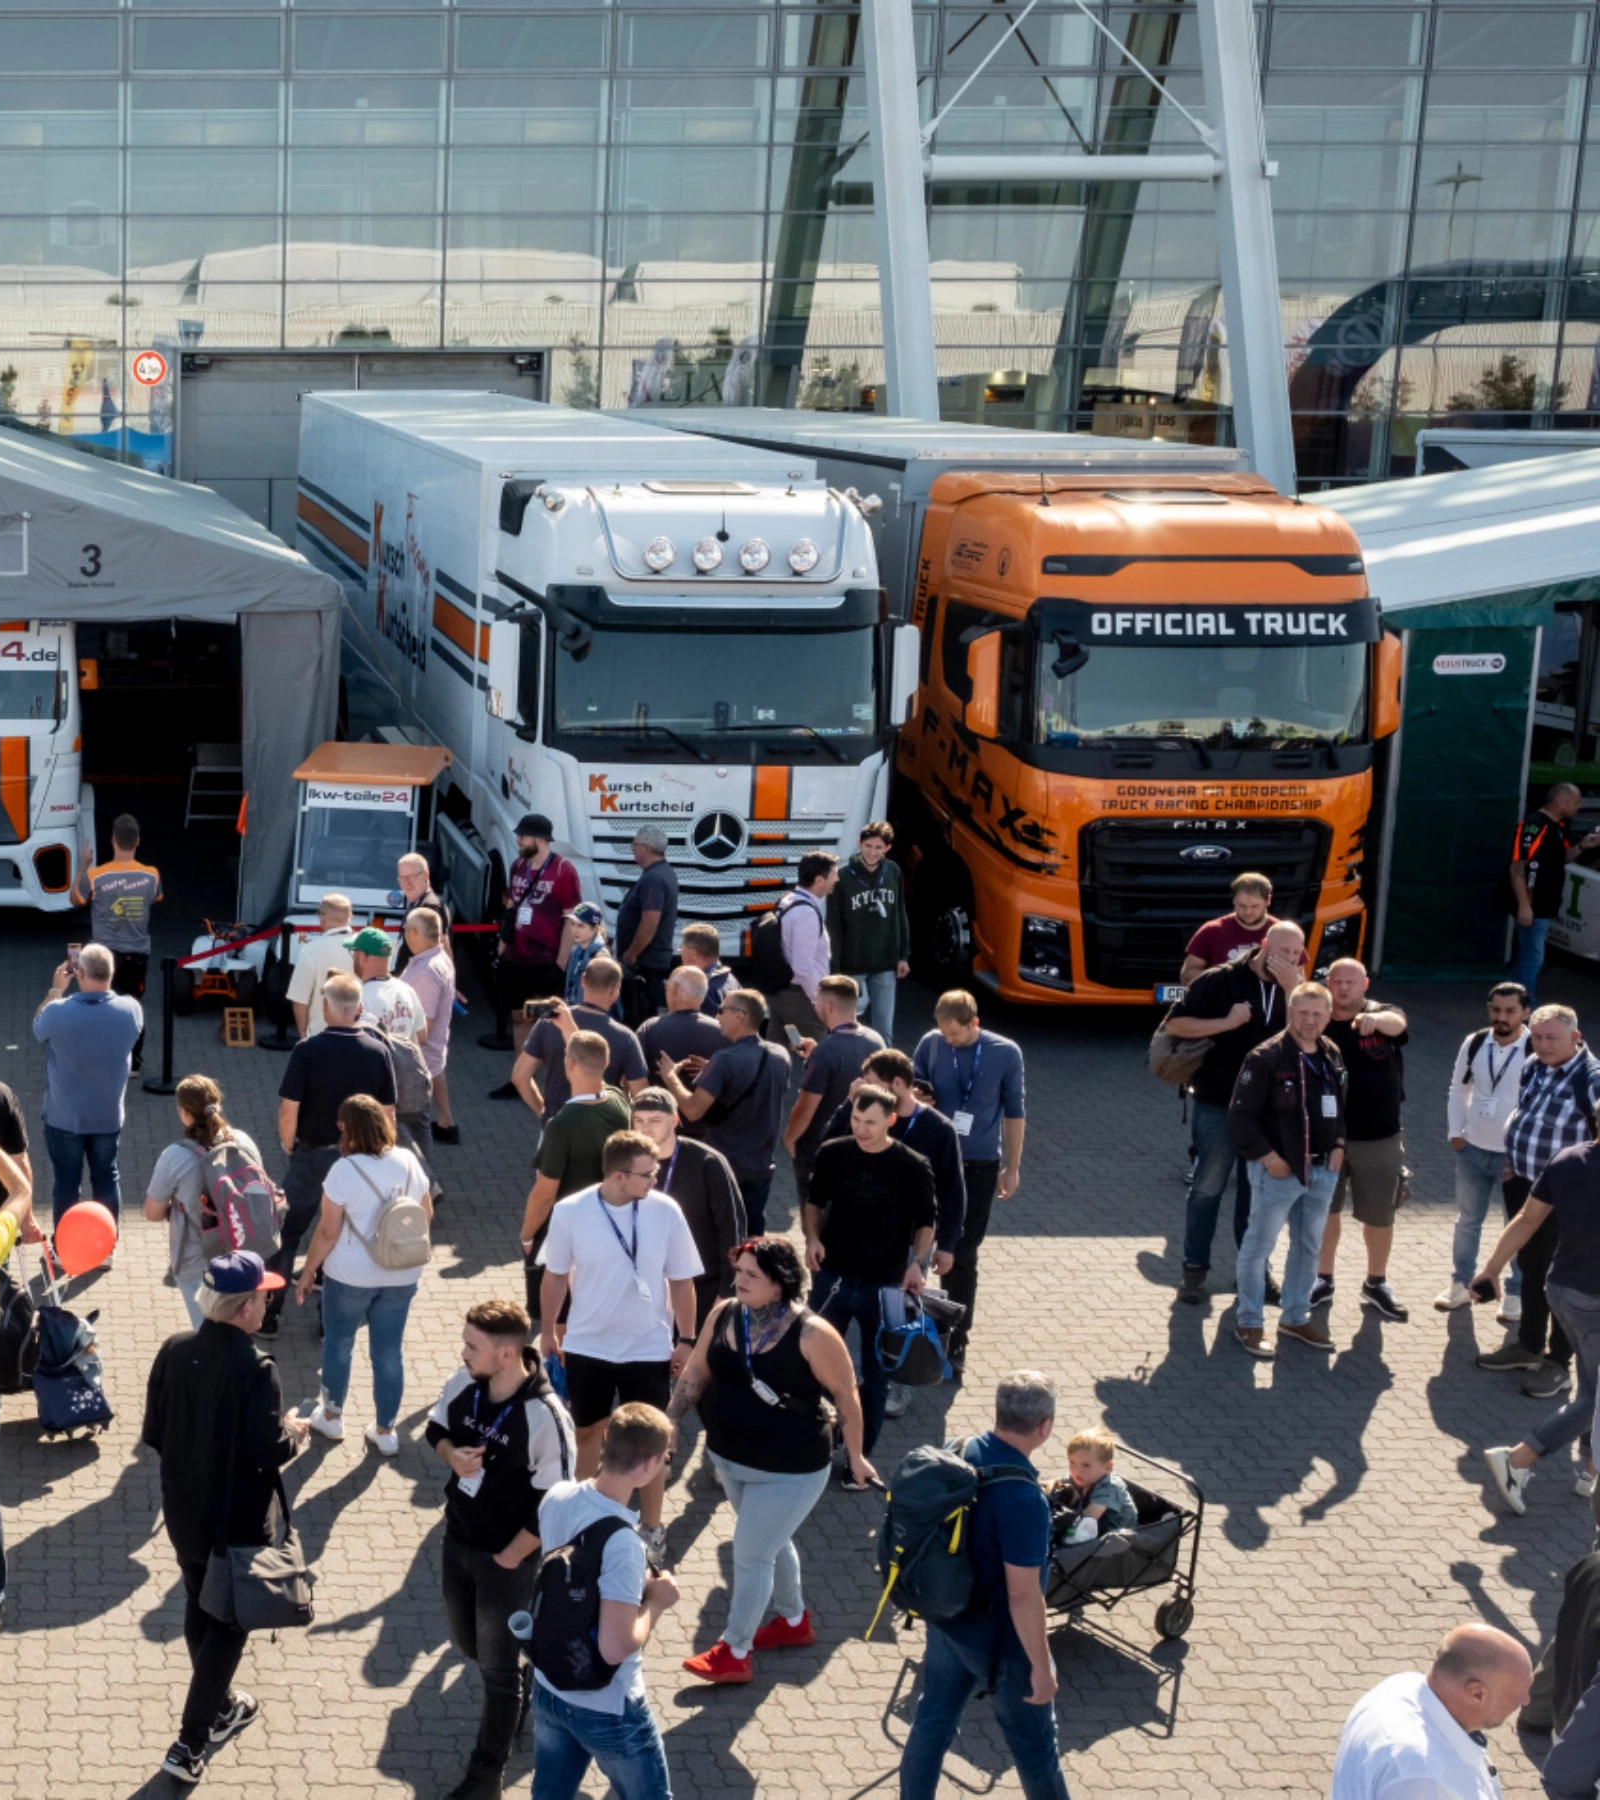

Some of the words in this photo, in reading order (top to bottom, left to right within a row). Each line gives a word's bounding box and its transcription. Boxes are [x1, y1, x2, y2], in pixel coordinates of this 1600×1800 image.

[79, 544, 101, 577] 3
[914, 557, 931, 622] TRUCK
[1091, 612, 1235, 636] OFFICIAL
[1244, 612, 1348, 636] TRUCK
[588, 773, 653, 793] Kursch
[1116, 785, 1197, 797] GOODYEAR
[1232, 785, 1308, 797] EUROPEAN
[307, 787, 410, 804] lkw-teile24
[600, 794, 695, 813] Kurtscheid
[1100, 799, 1149, 811] TRUCK
[1155, 799, 1210, 811] RACING
[1215, 799, 1322, 811] CHAMPIONSHIP
